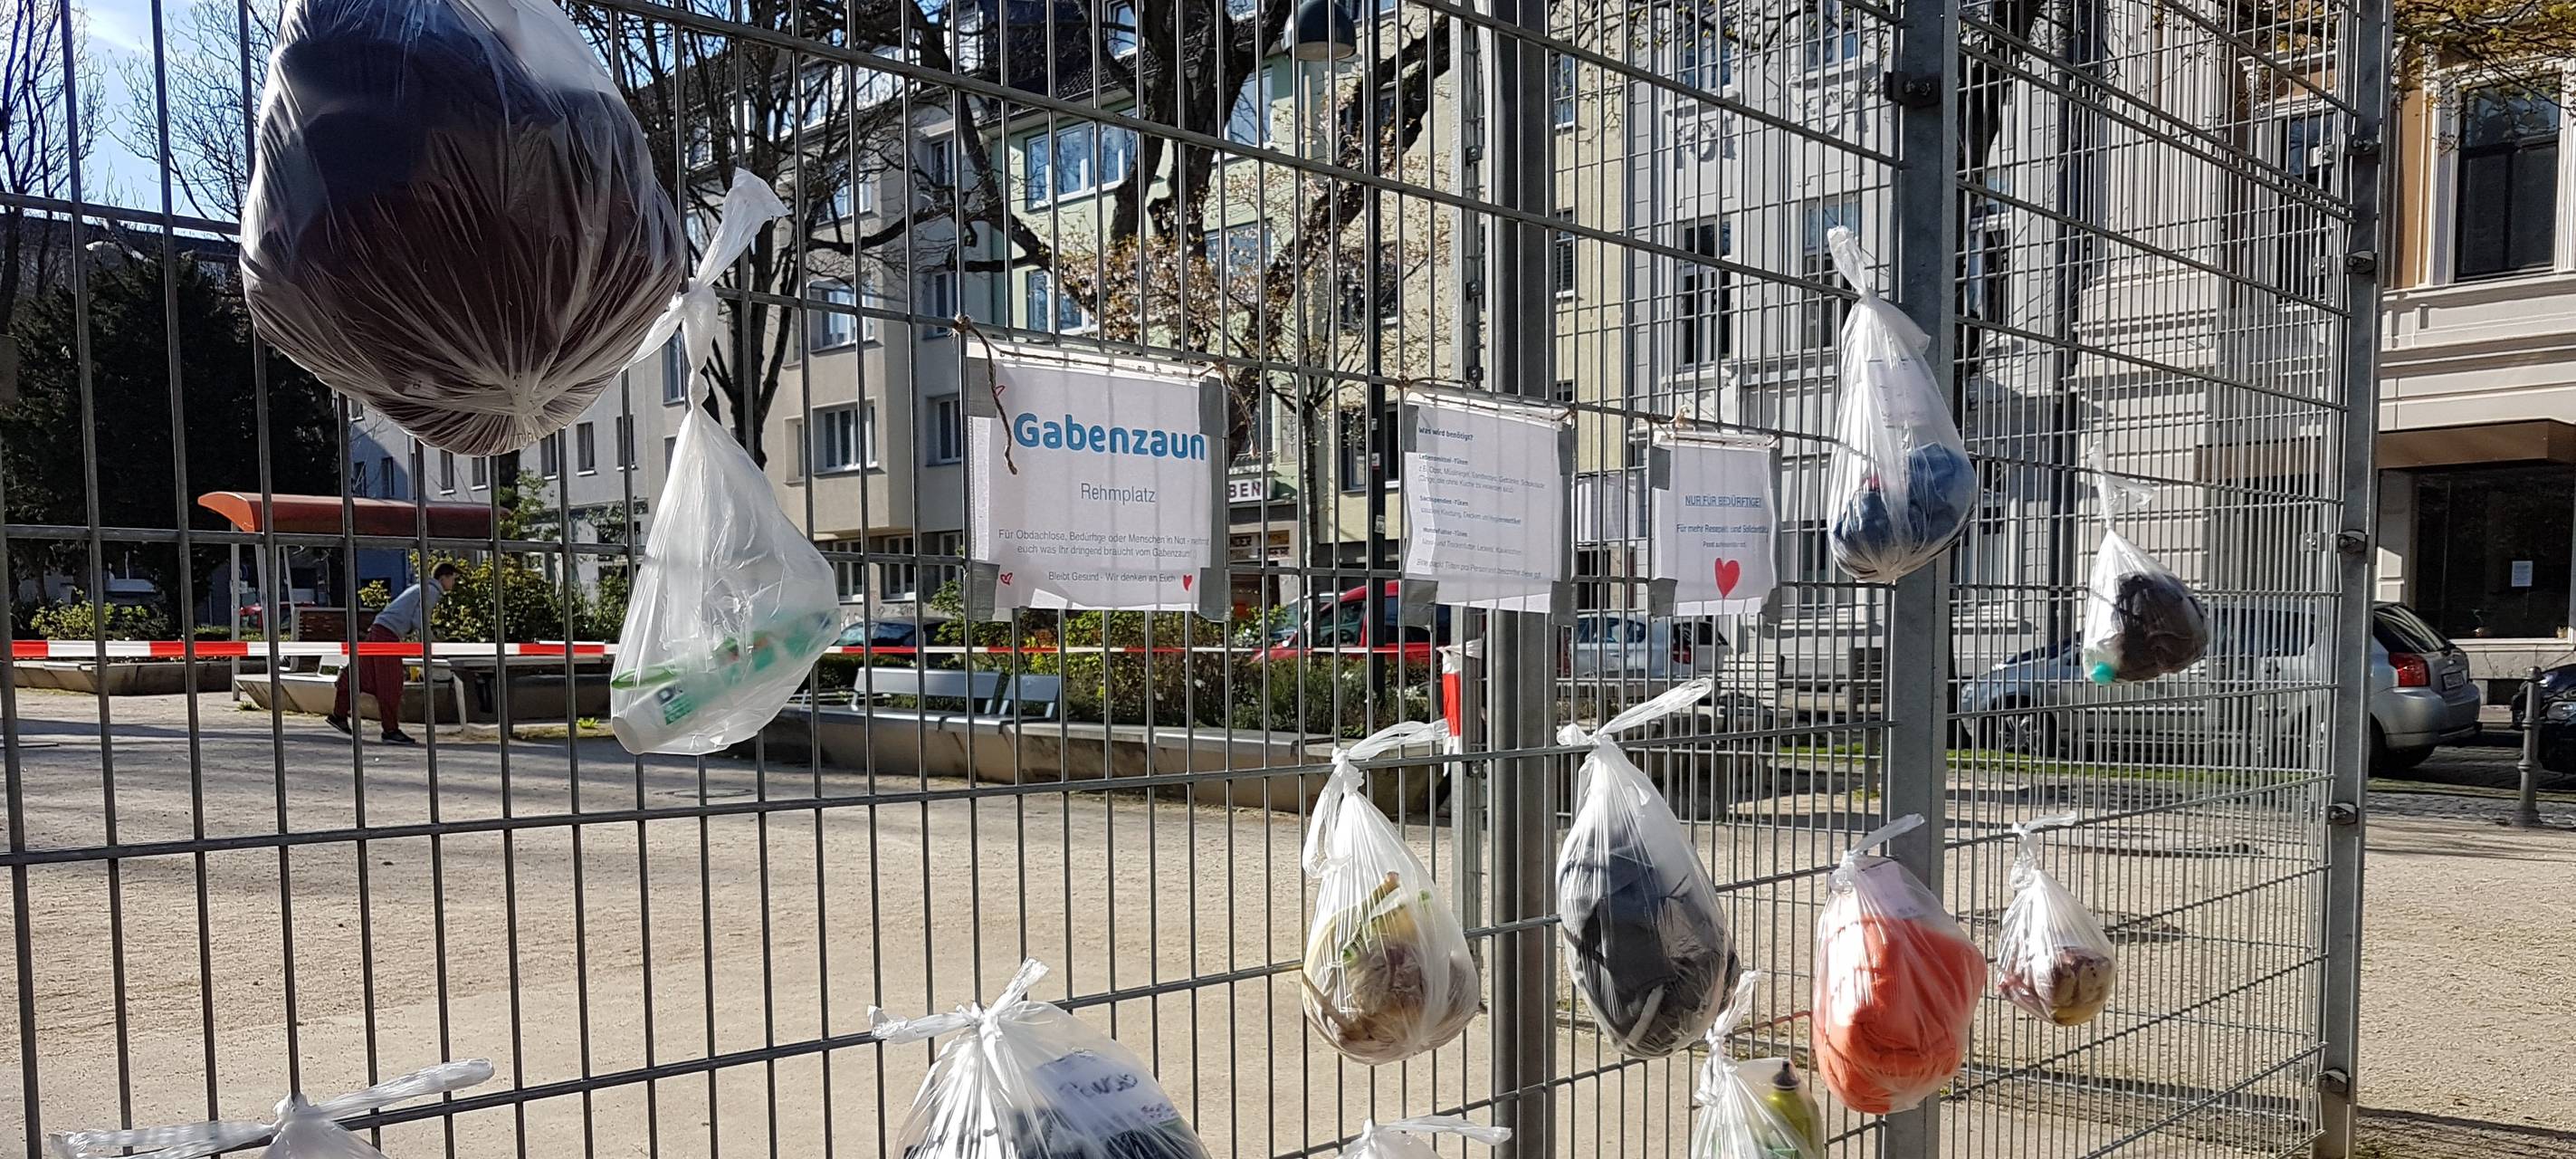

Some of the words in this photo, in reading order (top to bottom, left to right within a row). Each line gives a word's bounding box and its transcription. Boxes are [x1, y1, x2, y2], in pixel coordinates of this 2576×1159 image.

[1013, 412, 1205, 461] Gabenzaun
[1432, 427, 1445, 436] wird
[1081, 482, 1156, 505] Rehmplatz
[1685, 494, 1702, 507] NUR
[1703, 494, 1718, 507] FÜR
[1677, 524, 1687, 533] Für
[1688, 524, 1703, 533] mehr
[998, 529, 1014, 540] Für
[1016, 529, 1068, 541] Obdachlose,
[1069, 531, 1106, 544] Bedürftige
[1108, 533, 1127, 544] oder
[1128, 533, 1167, 544] Menschen
[1167, 535, 1173, 544] in
[1174, 535, 1186, 545] Not
[1016, 544, 1038, 554] euch
[1039, 546, 1057, 554] was
[1070, 545, 1102, 557] dringend
[1103, 546, 1133, 556] braucht
[1134, 548, 1151, 557] vom
[1048, 570, 1070, 580] Bleibt
[1071, 571, 1099, 581] Gesund
[1105, 571, 1120, 581] Wir
[1121, 572, 1147, 582] denken
[1149, 574, 1159, 582] an
[1159, 573, 1176, 583] Euch
